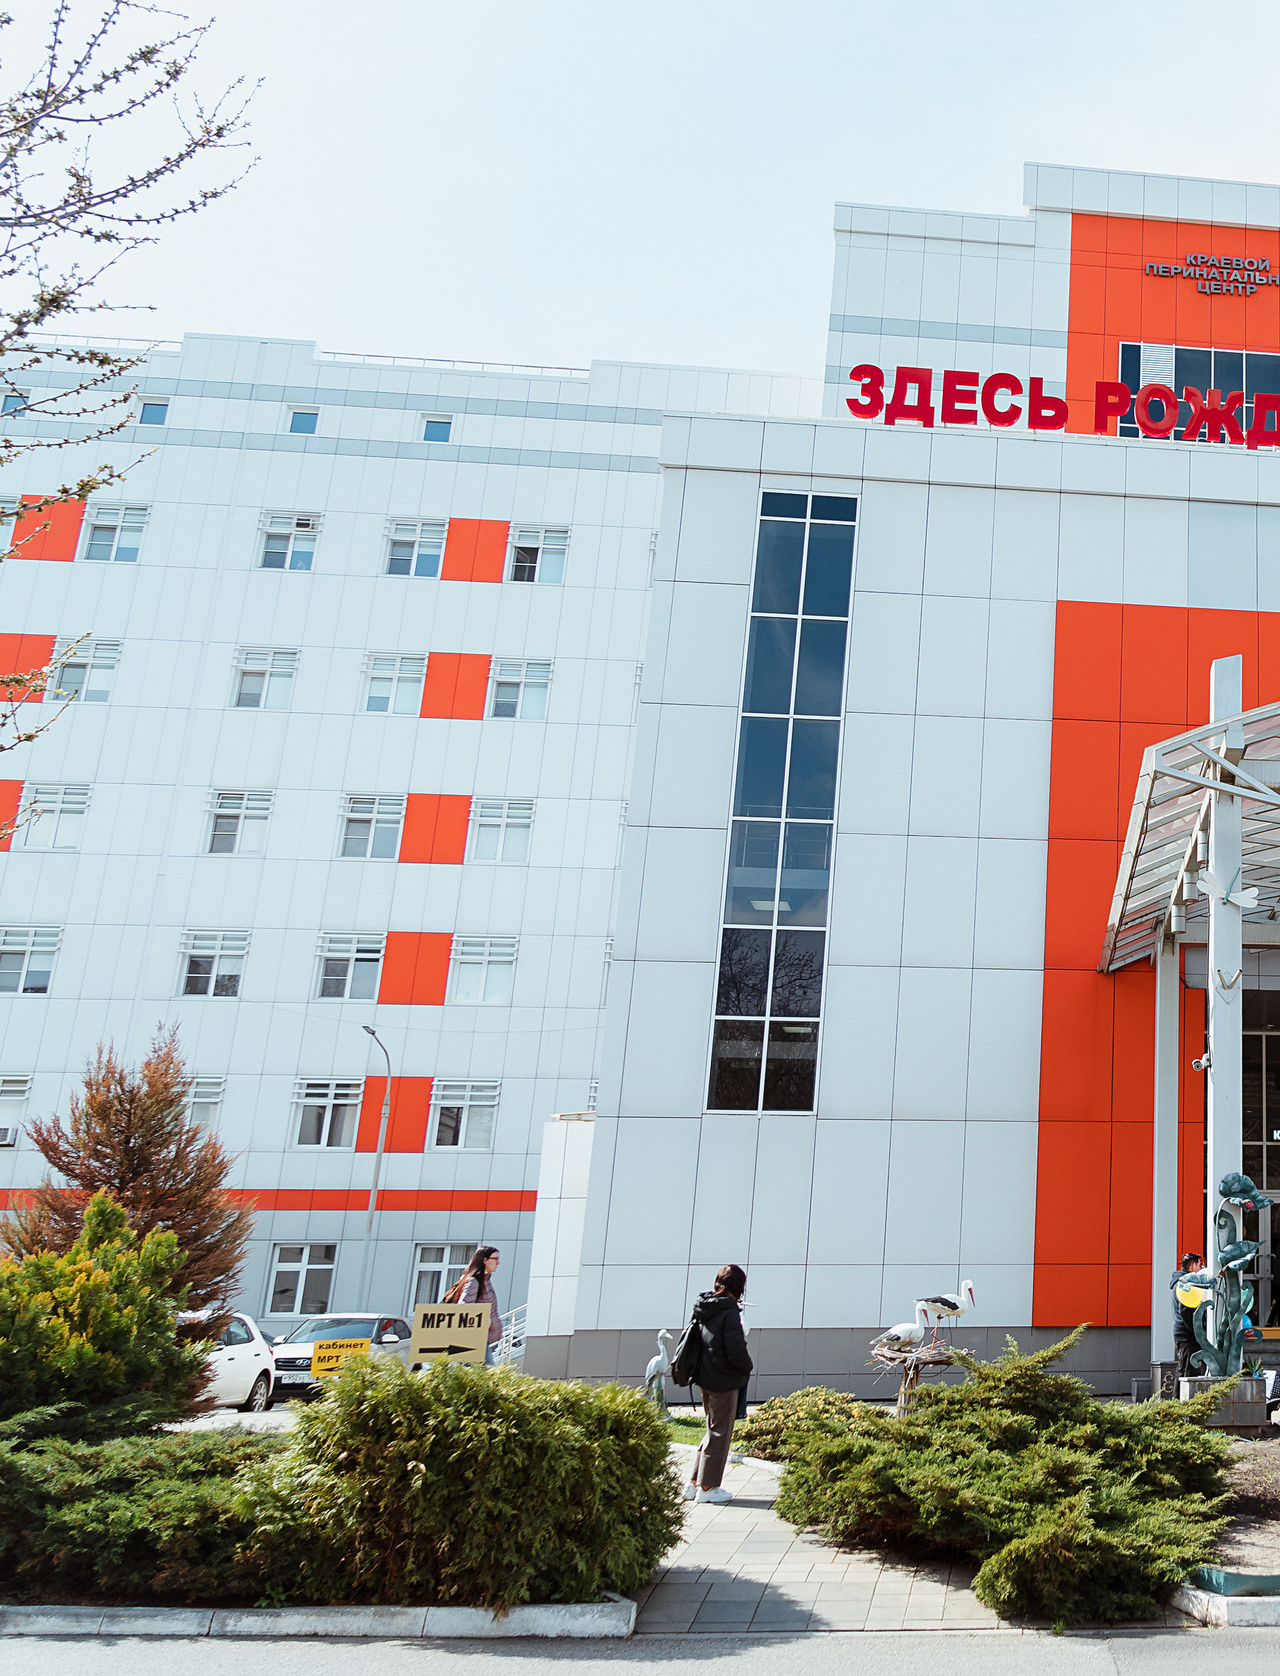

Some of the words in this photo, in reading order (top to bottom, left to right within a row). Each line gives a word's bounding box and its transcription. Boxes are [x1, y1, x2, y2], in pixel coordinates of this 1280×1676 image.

[1186, 253, 1270, 272] КРАЕВОЙ
[1197, 280, 1258, 296] ЦЕНТР
[846, 364, 1069, 430] ЗДЕСЬ
[421, 1312, 456, 1329] МРТ
[458, 1312, 483, 1329] №1
[318, 1341, 365, 1350] кабинет
[317, 1355, 341, 1363] МРТ
